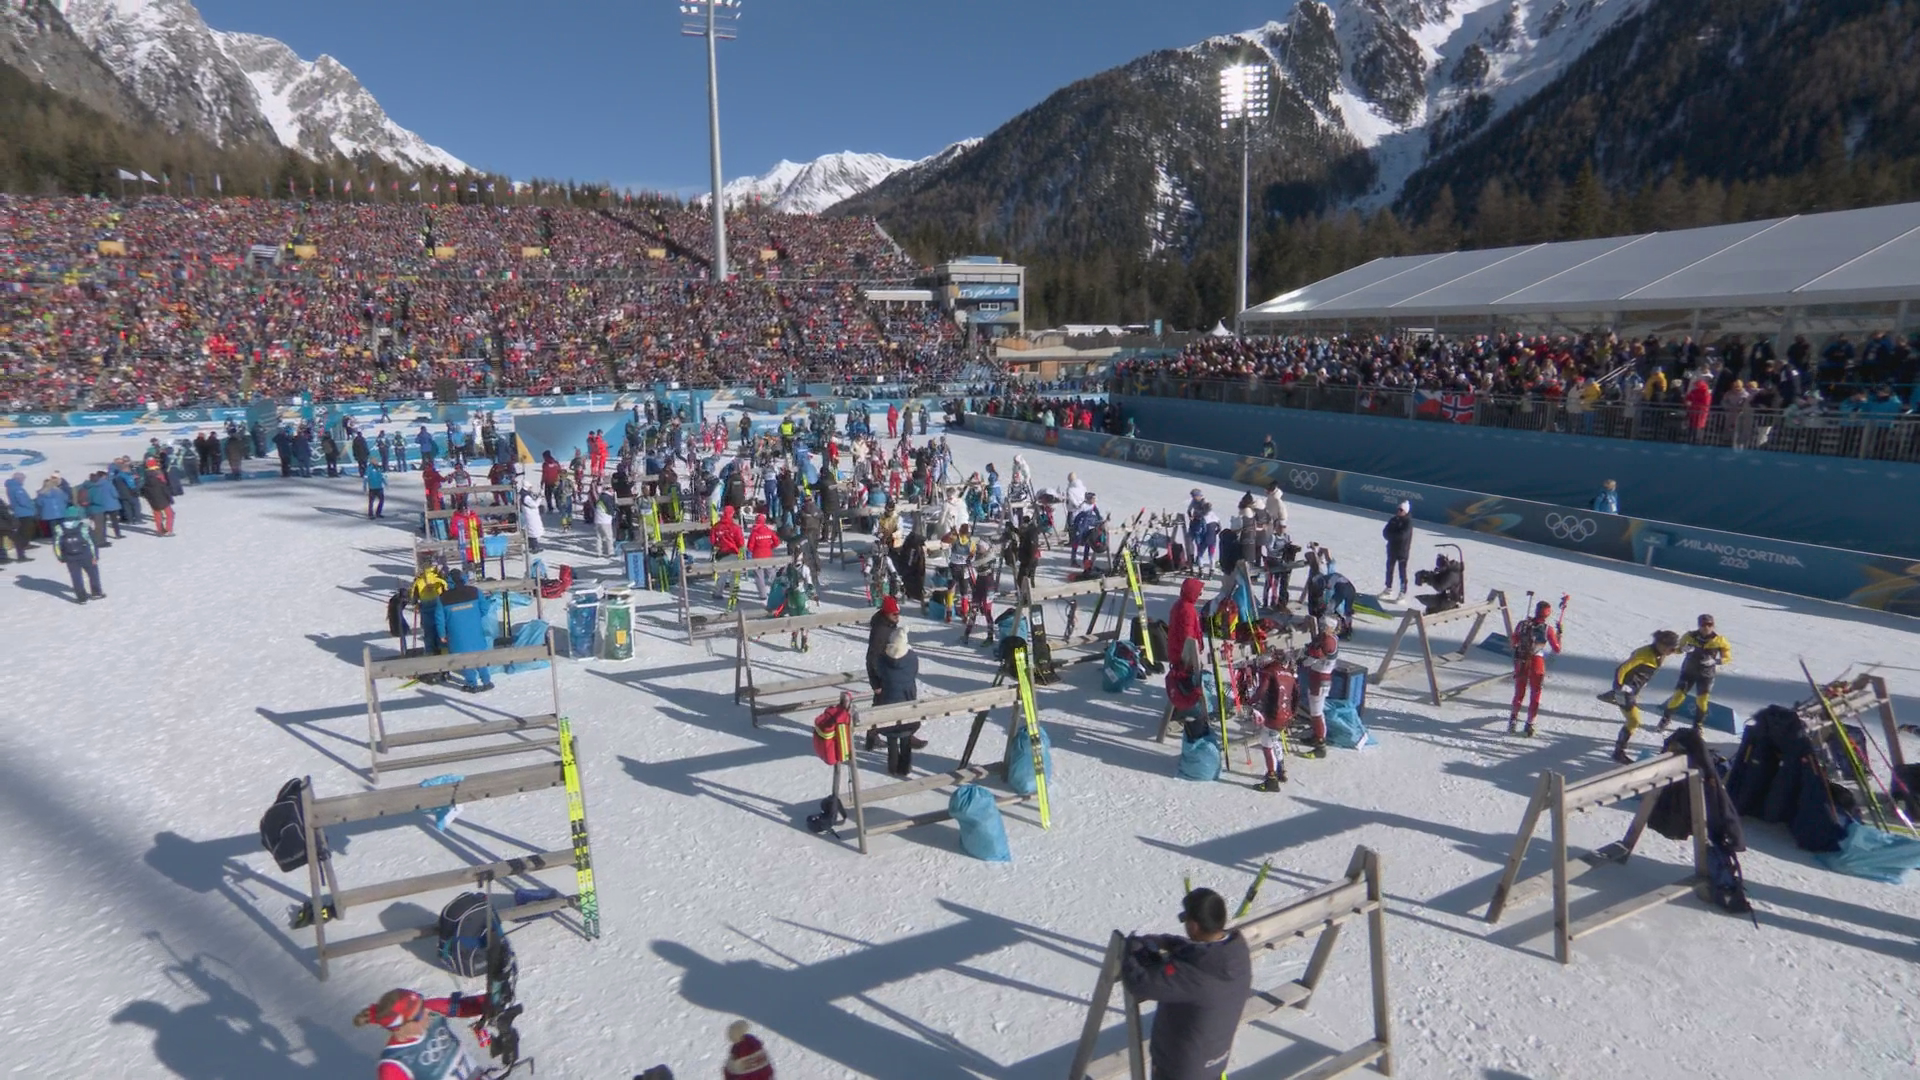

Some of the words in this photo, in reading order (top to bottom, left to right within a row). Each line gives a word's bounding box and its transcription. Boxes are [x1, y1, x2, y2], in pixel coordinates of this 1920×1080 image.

[1675, 538, 1735, 556] MILANO
[1736, 547, 1805, 569] CORTINA
[1719, 555, 1750, 570] 2026
